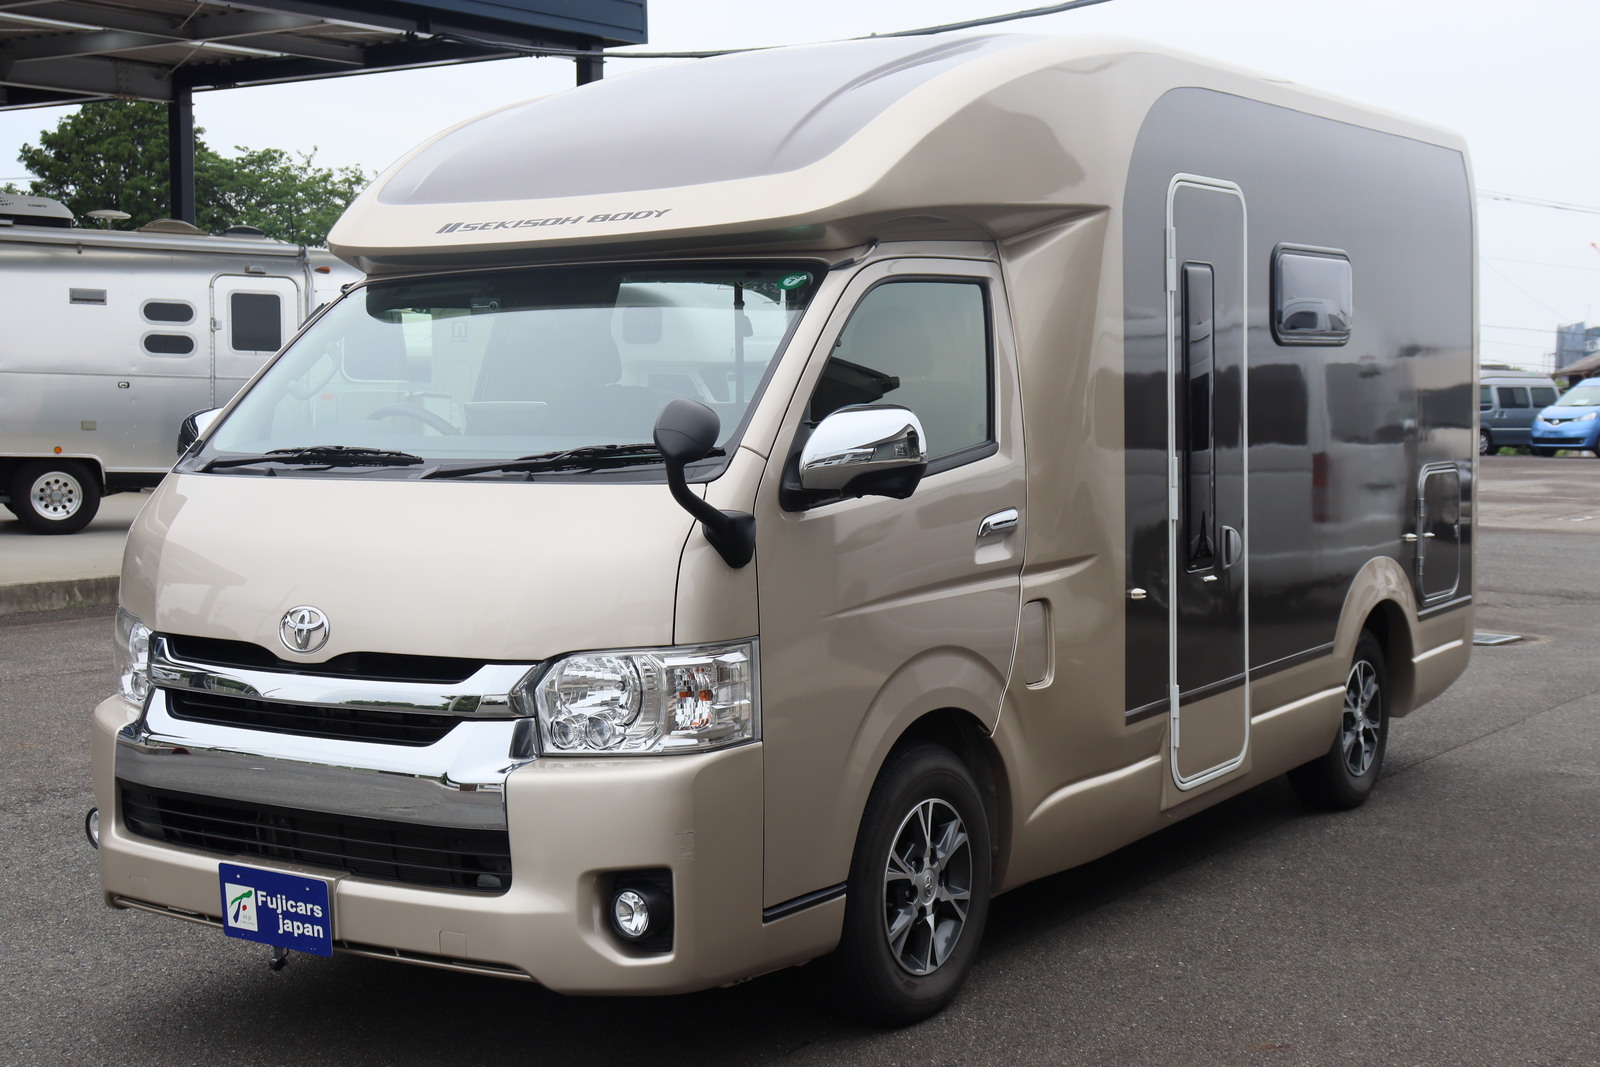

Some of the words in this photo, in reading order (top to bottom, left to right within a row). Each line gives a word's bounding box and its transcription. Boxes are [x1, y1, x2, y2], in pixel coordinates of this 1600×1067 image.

[457, 215, 585, 233] SEKISOH
[586, 208, 673, 224] BODY
[257, 890, 323, 918] Fujicars
[278, 915, 324, 939] japan
